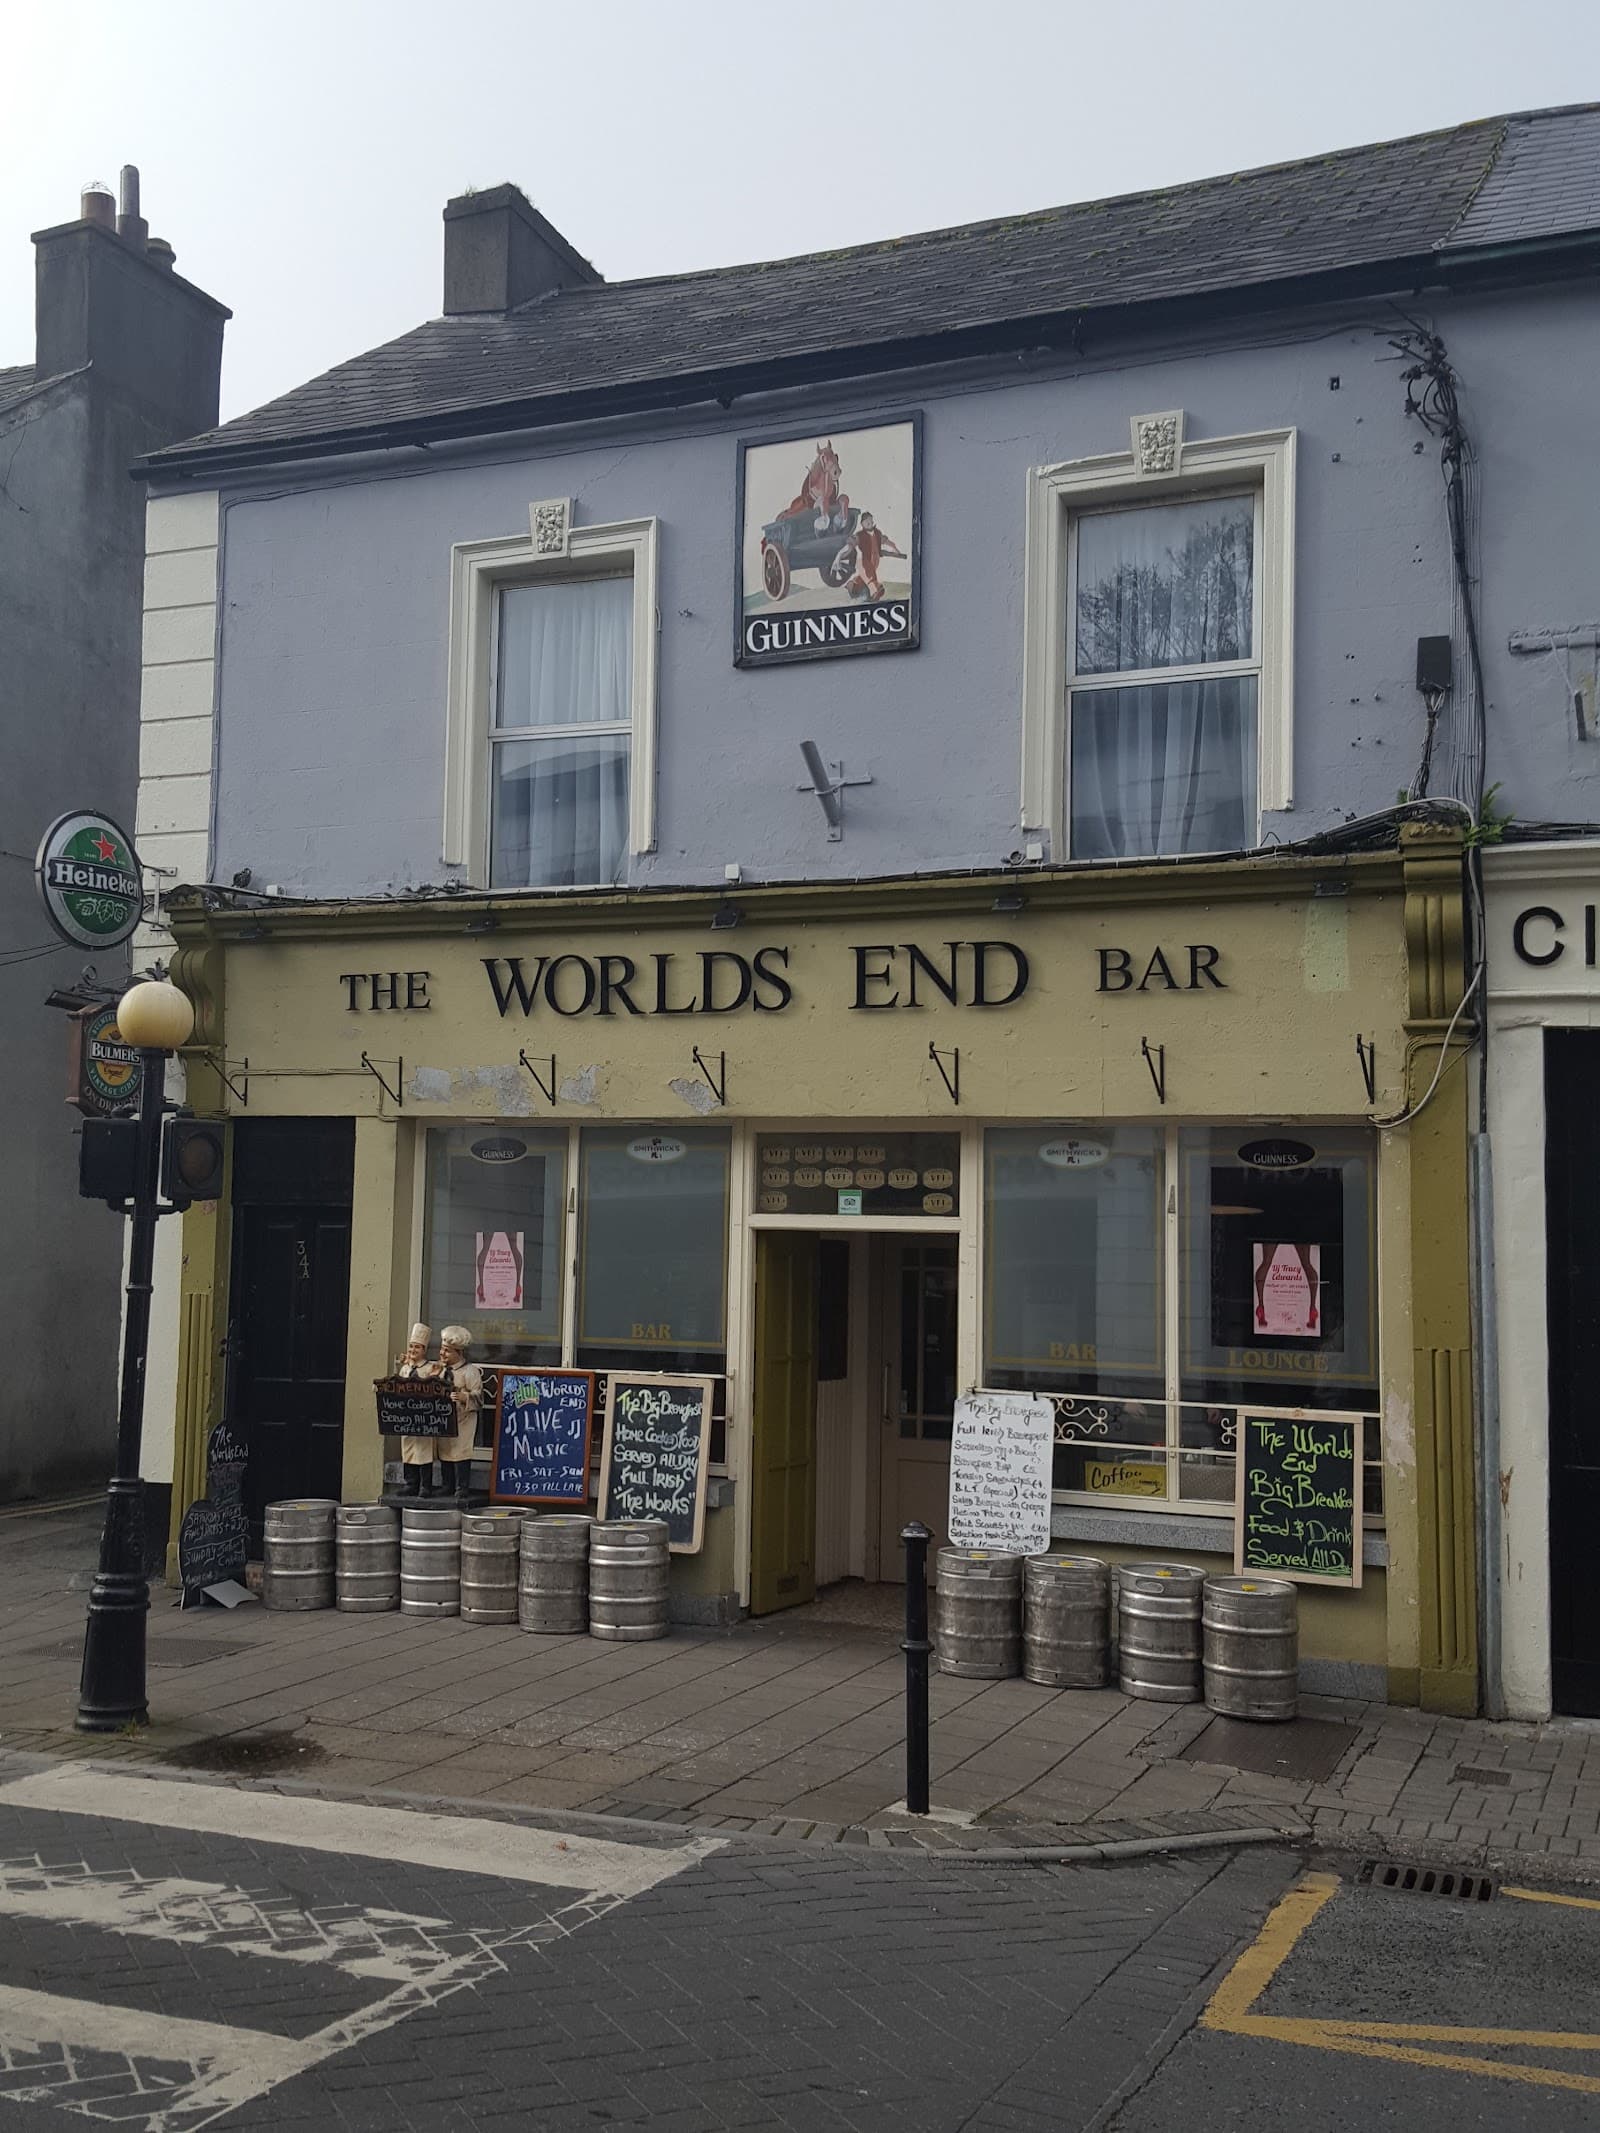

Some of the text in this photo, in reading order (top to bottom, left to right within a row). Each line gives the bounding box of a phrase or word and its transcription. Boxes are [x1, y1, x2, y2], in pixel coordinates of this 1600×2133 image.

[746, 604, 907, 653] GUINNESS
[54, 862, 140, 899] Heineken
[338, 940, 1229, 1019] THE WORLDS END BAR
[92, 1041, 140, 1063] BULMERS
[482, 1150, 514, 1159] GUINNESS
[1253, 1152, 1298, 1164] GUINNESS
[1272, 1273, 1303, 1281] Edwards
[631, 1323, 672, 1339] BAR
[1049, 1342, 1097, 1360] BAR
[1229, 1350, 1329, 1372] LOUNGE
[397, 1382, 431, 1393] MENU
[559, 1396, 588, 1410] END
[523, 1407, 564, 1432] LIVE
[957, 1421, 976, 1434] Full
[214, 1425, 233, 1449] The
[1251, 1421, 1353, 1460] The Worlds
[1281, 1452, 1317, 1473] End
[620, 1465, 649, 1485] Full
[1249, 1468, 1294, 1516] Big
[1247, 1514, 1290, 1537] Food
[1247, 1538, 1309, 1568] Served
